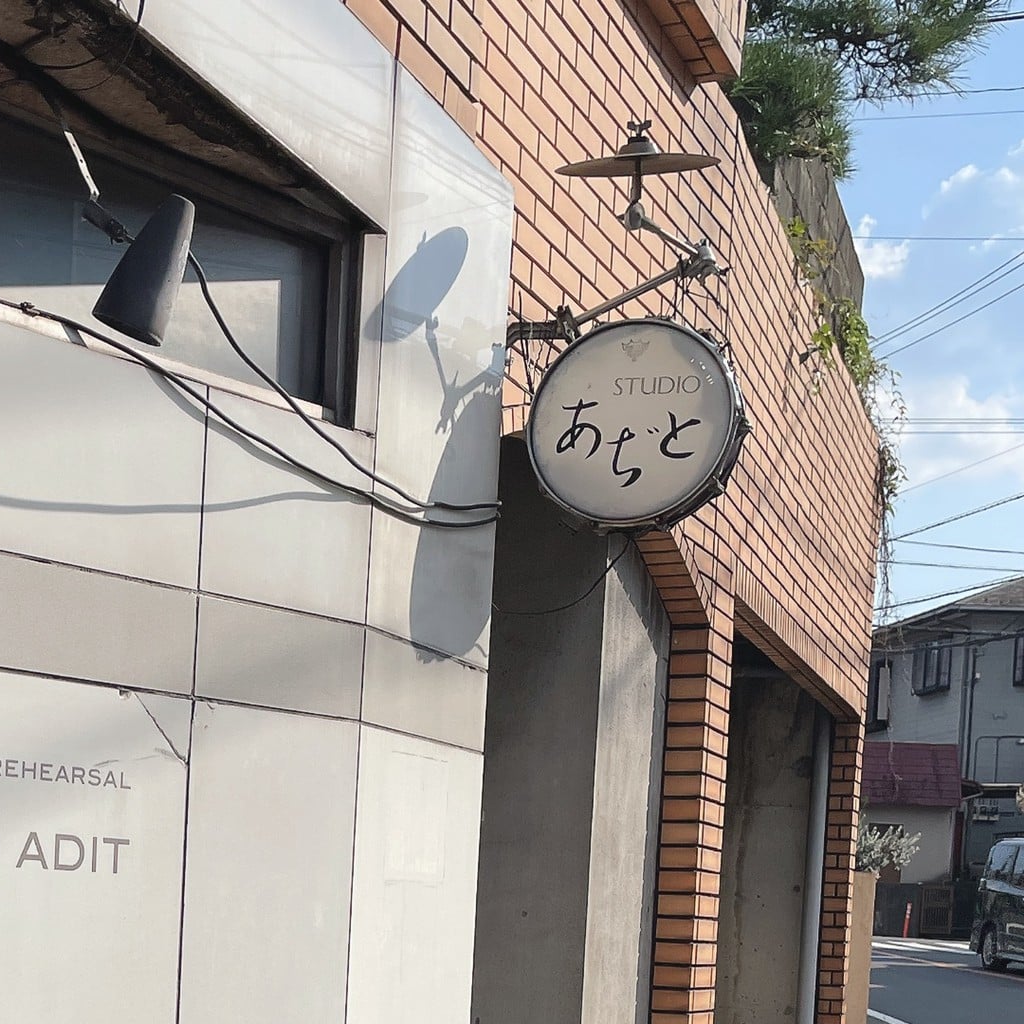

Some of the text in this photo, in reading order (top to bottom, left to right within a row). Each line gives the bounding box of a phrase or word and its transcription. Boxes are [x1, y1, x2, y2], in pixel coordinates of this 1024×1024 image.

[612, 375, 701, 396] STUDIO
[555, 398, 701, 488] あぢと
[15, 831, 131, 874] ADIT
